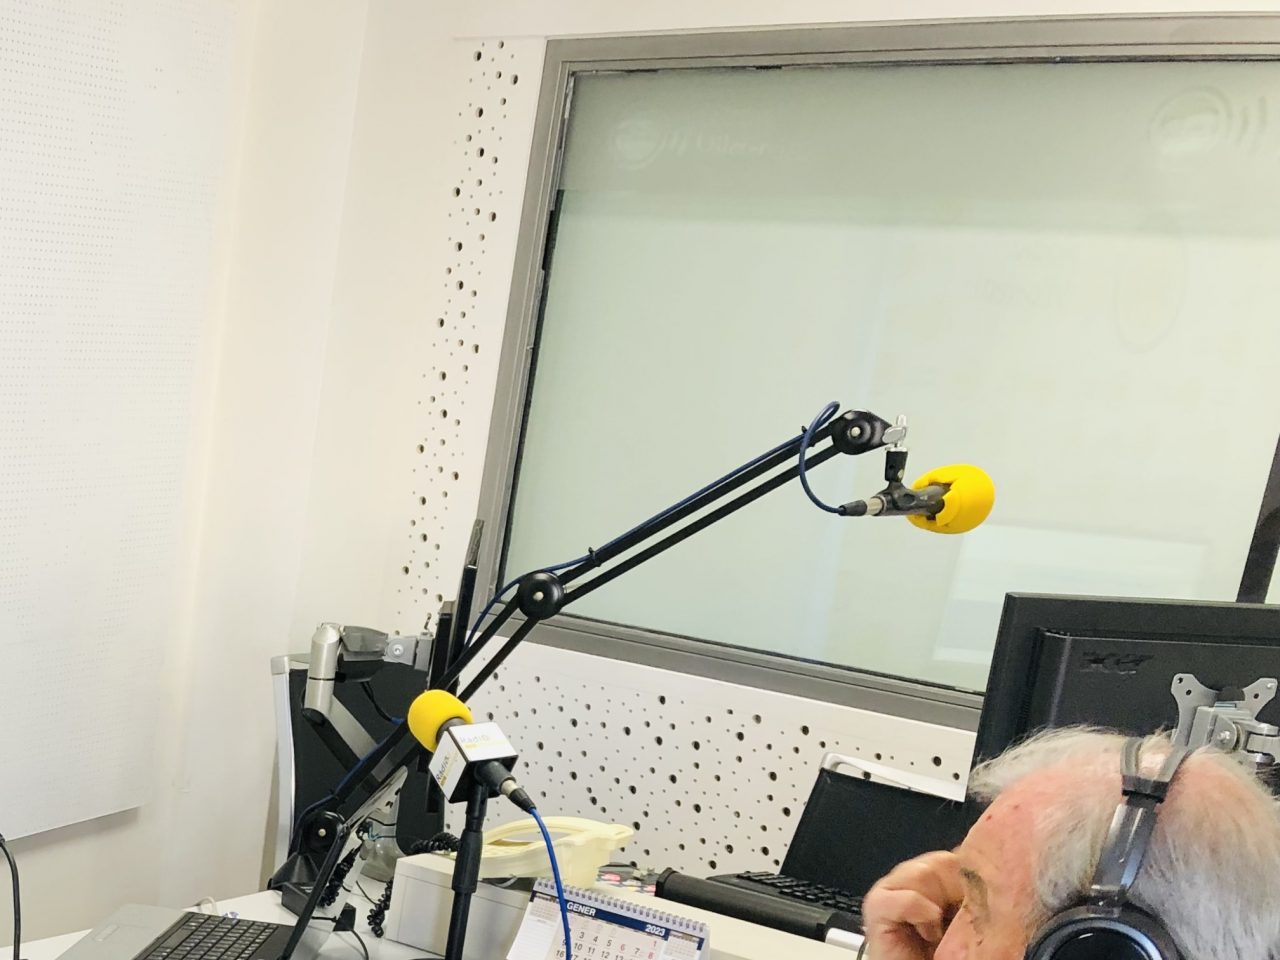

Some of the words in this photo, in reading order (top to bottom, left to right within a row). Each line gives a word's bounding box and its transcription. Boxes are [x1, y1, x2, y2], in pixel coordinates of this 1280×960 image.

[567, 901, 597, 917] GENER
[645, 924, 666, 937] 2023
[574, 942, 583, 951] 10
[587, 946, 596, 955] 11
[600, 950, 611, 959] 12
[579, 931, 585, 939] 3
[606, 939, 613, 947] 5
[634, 947, 640, 955] 7
[556, 949, 565, 958] 16
